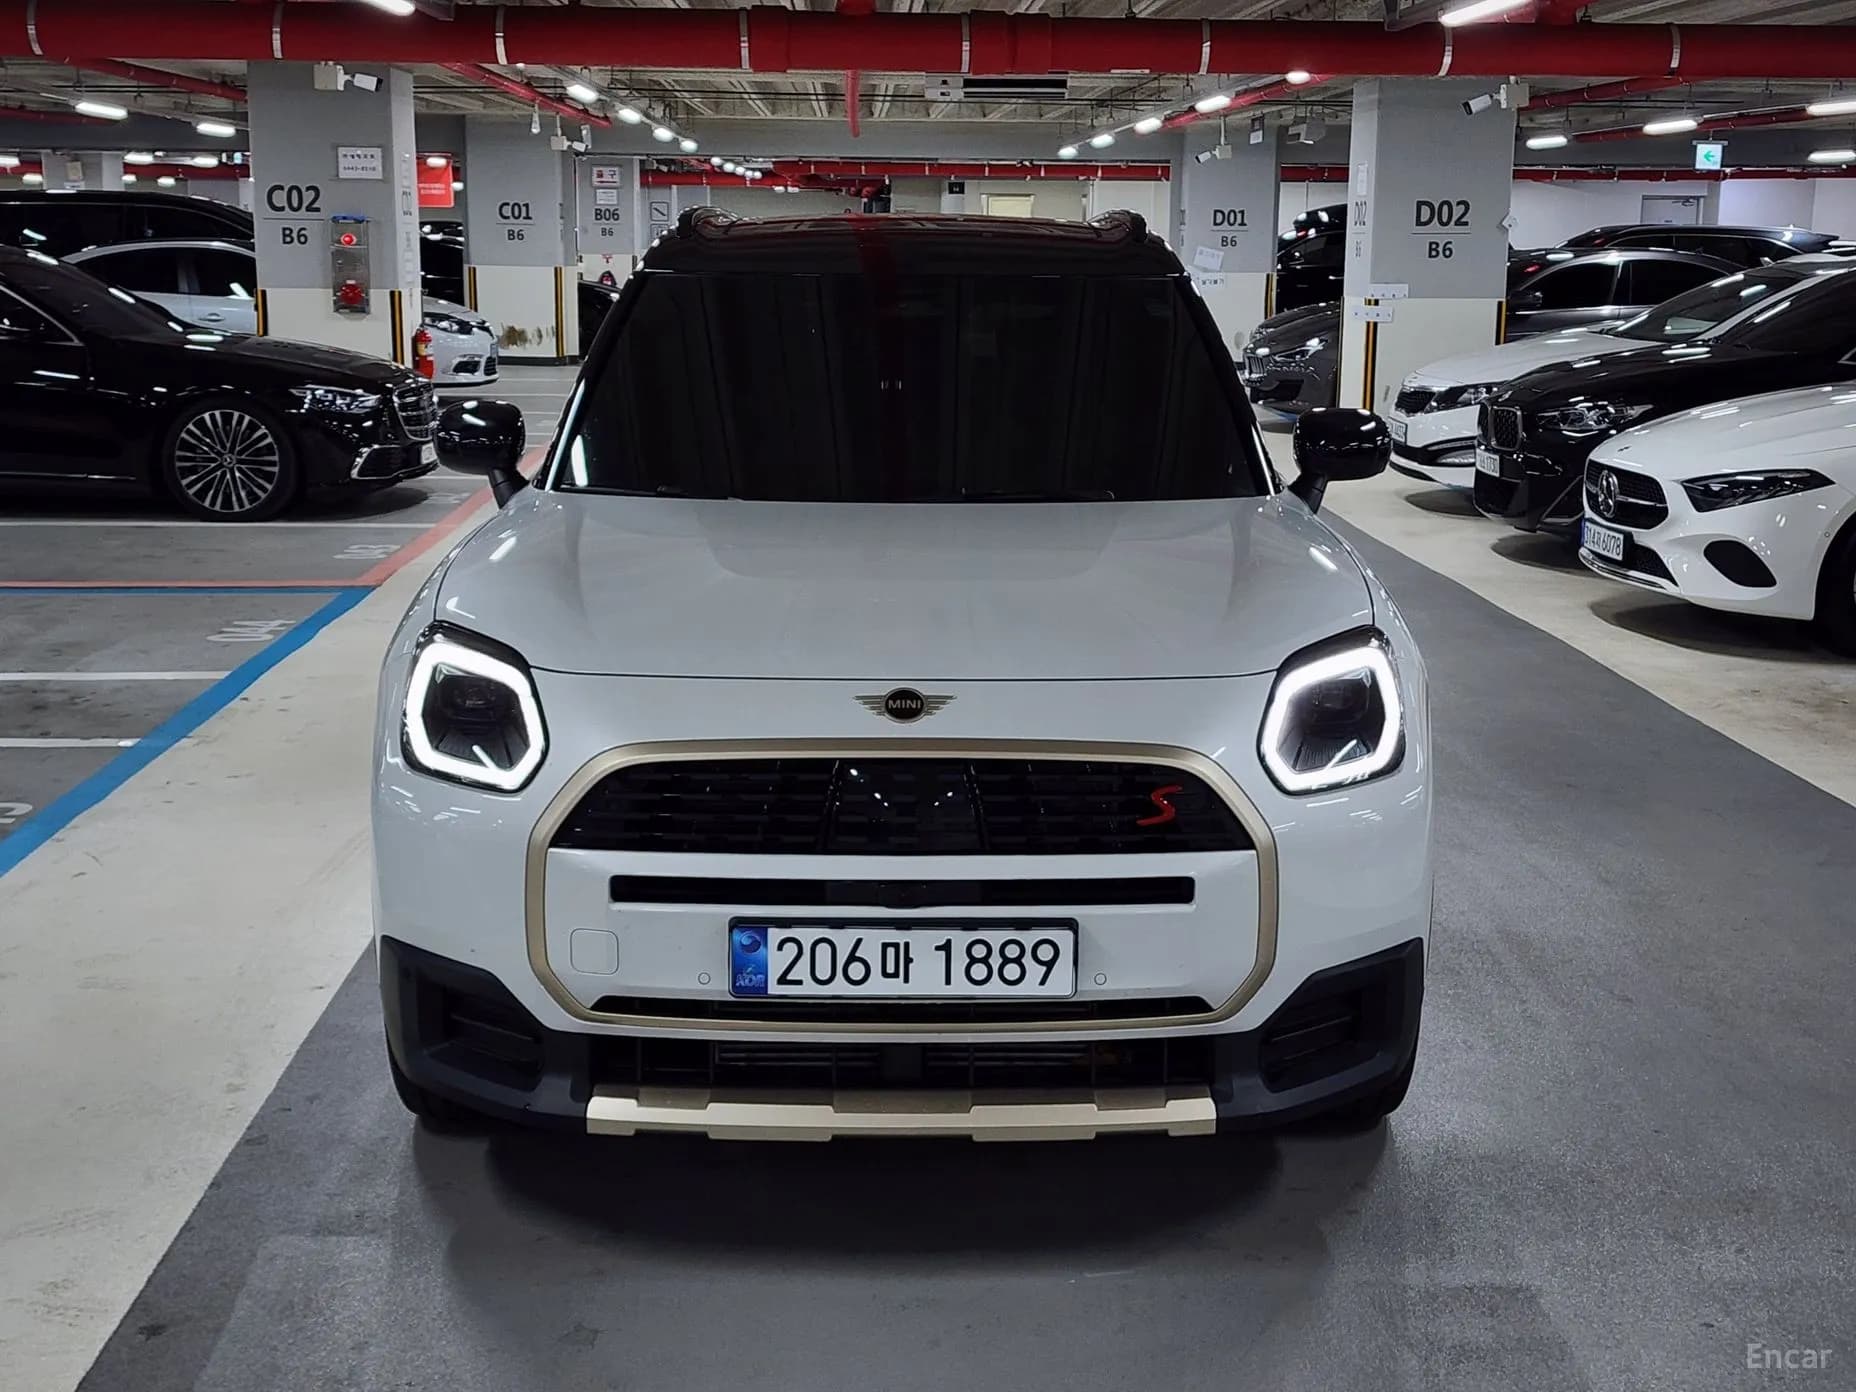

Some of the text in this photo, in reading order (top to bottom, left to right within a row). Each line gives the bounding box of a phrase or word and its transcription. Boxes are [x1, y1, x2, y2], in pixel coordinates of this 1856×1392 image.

[266, 184, 321, 213] C02
[498, 201, 533, 221] C01
[594, 207, 620, 222] B06
[1212, 209, 1248, 227] D01
[1415, 199, 1471, 227] D02
[281, 226, 308, 245] B6
[507, 228, 525, 241] B6
[600, 227, 614, 237] B6
[1221, 235, 1238, 248] B6
[1427, 240, 1454, 259] B6
[888, 699, 921, 709] MINI
[1135, 784, 1182, 826] S
[776, 936, 1061, 986] 206마 1889
